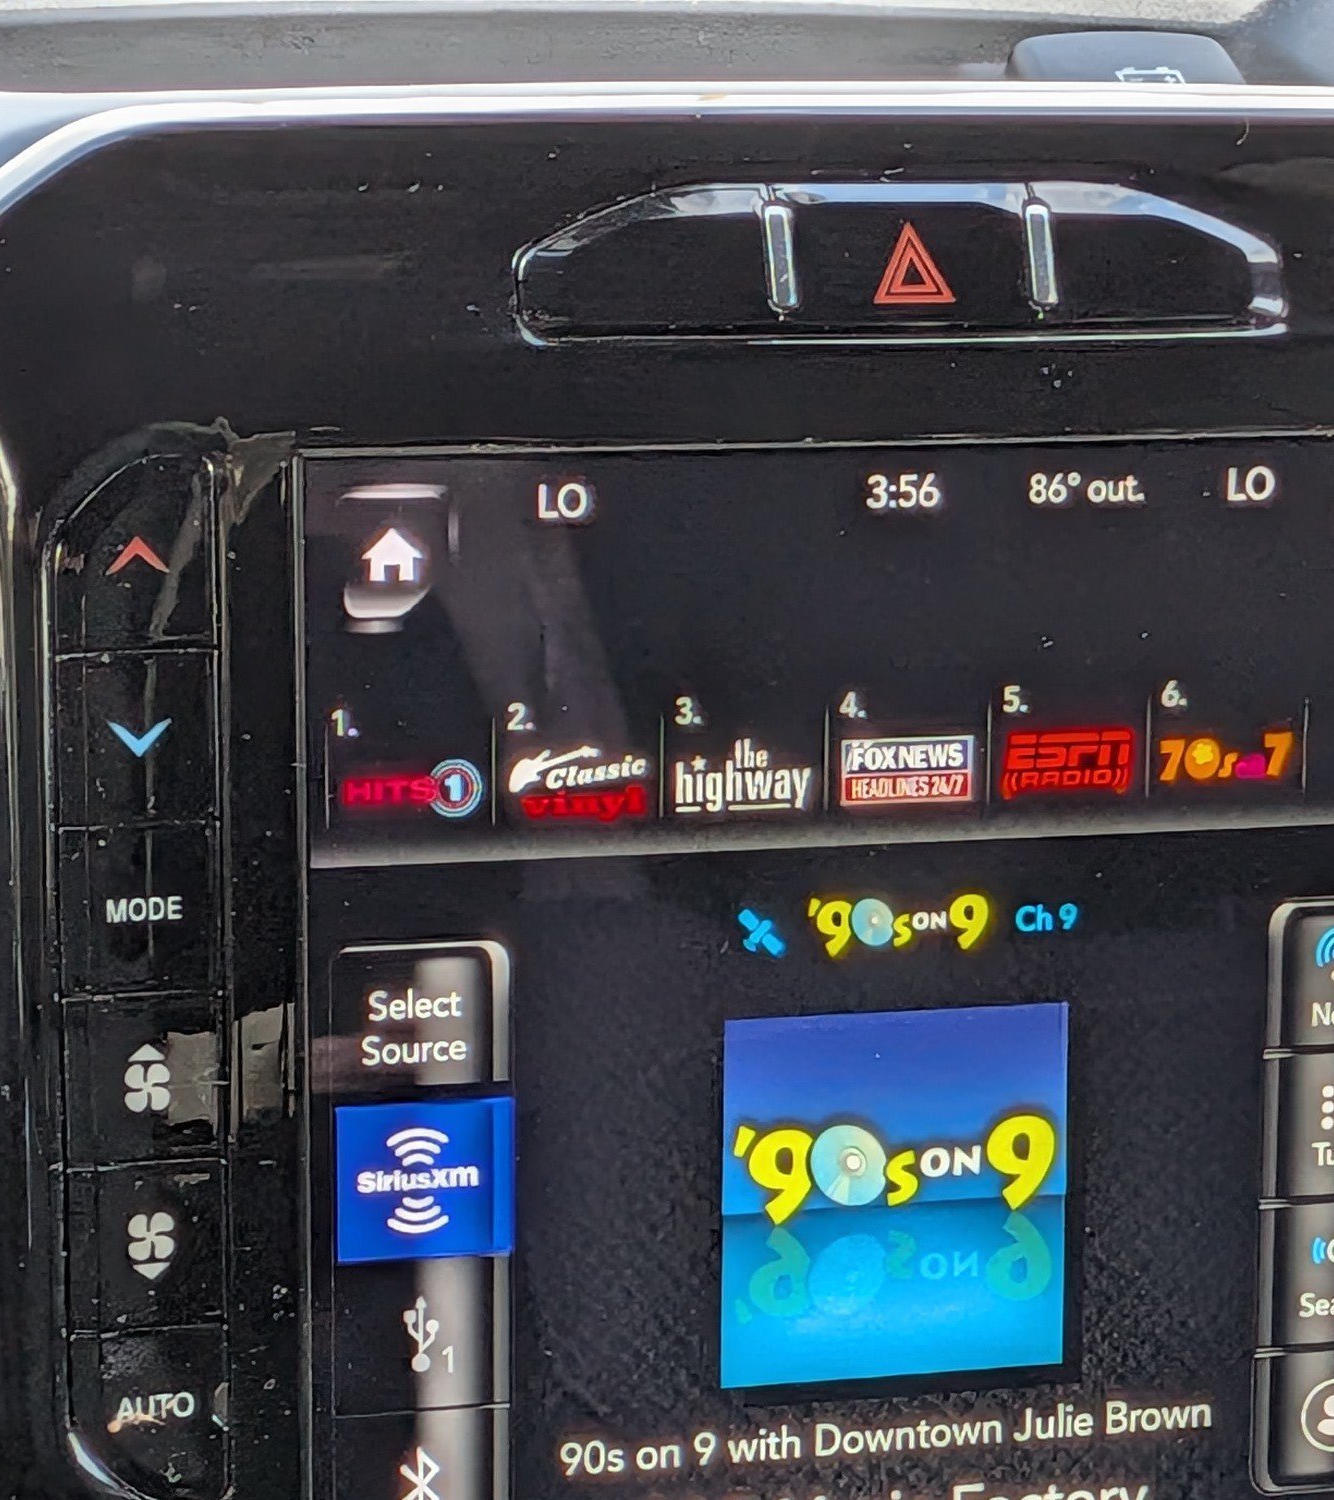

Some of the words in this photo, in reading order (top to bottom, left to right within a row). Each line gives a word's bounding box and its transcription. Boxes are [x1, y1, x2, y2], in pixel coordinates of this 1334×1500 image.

[867, 473, 940, 509] 3:56
[1030, 473, 1080, 504] 86°
[1088, 475, 1144, 501] out.
[1227, 467, 1275, 501] LO
[538, 482, 588, 520] LO
[839, 691, 866, 718] 4.
[1003, 685, 1030, 712] 5.
[1161, 681, 1187, 708] 6.
[331, 709, 359, 737] 1.
[507, 703, 535, 731] 2.
[675, 696, 702, 726] 3.
[735, 738, 768, 764] the
[1007, 731, 1131, 769] ESPN
[545, 755, 647, 788] Classic
[675, 756, 811, 812] highway
[851, 775, 929, 799] HEADLINES
[930, 775, 964, 797] 24/7
[344, 776, 435, 804] HITS
[521, 786, 646, 821] vinyl
[106, 896, 183, 924] MODE
[912, 911, 947, 931] ON
[949, 894, 989, 950] 9
[1015, 904, 1052, 932] Ch
[1060, 903, 1079, 929] 9
[368, 988, 462, 1022] Select
[361, 1036, 468, 1067] Source
[920, 1145, 981, 1178] ON
[986, 1115, 1055, 1211] 9
[115, 1391, 195, 1422] AUTO
[560, 1440, 624, 1477] 90s
[635, 1440, 680, 1470] on
[693, 1432, 717, 1468] 9
[729, 1426, 801, 1465] with
[814, 1413, 1003, 1458] Downtown
[1013, 1401, 1093, 1445] Julie
[1106, 1400, 1212, 1437] Brown
